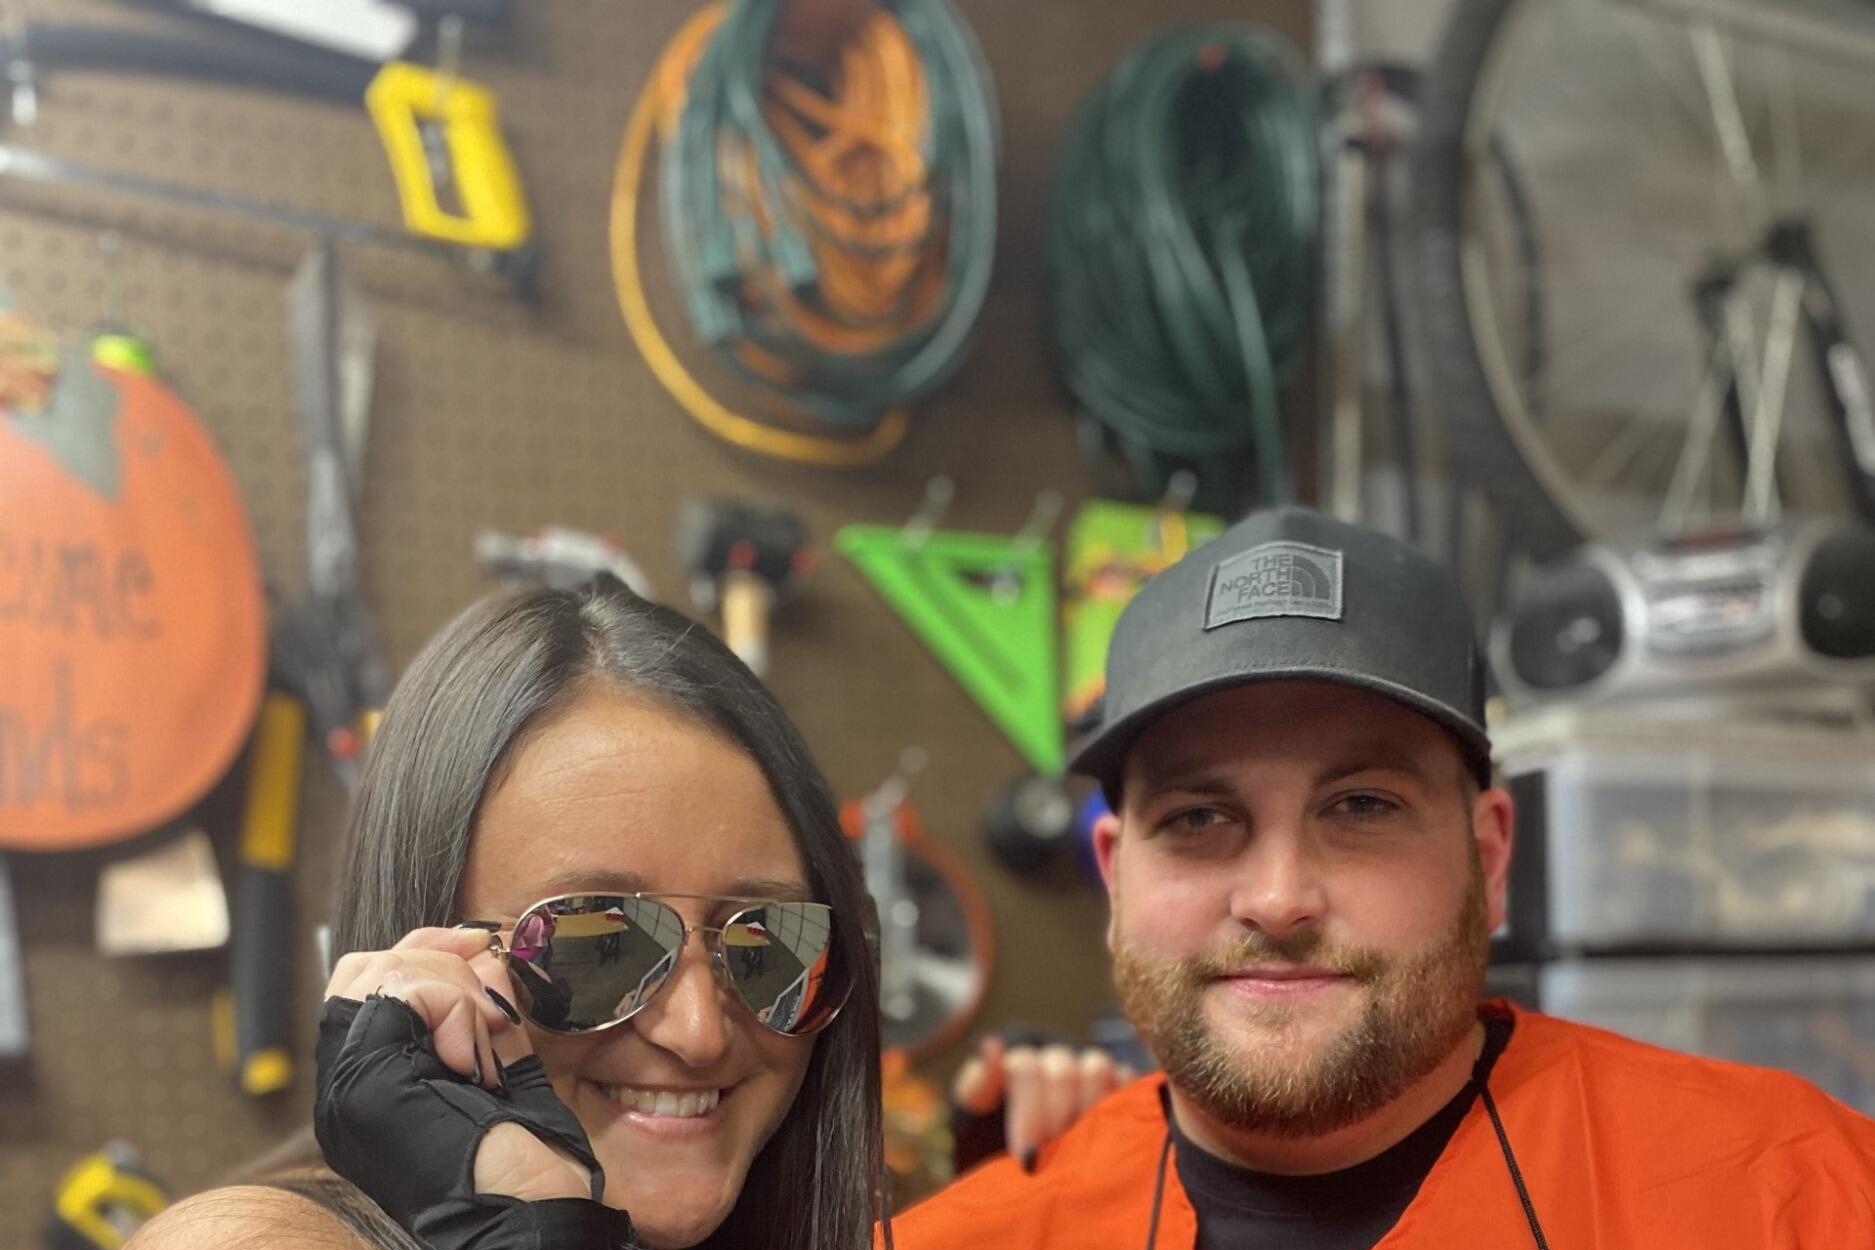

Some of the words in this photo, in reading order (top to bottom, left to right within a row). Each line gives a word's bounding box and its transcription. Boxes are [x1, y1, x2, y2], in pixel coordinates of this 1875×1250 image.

[1251, 554, 1292, 570] THE
[1220, 567, 1292, 595] NORTH
[1238, 580, 1291, 602] FACE
